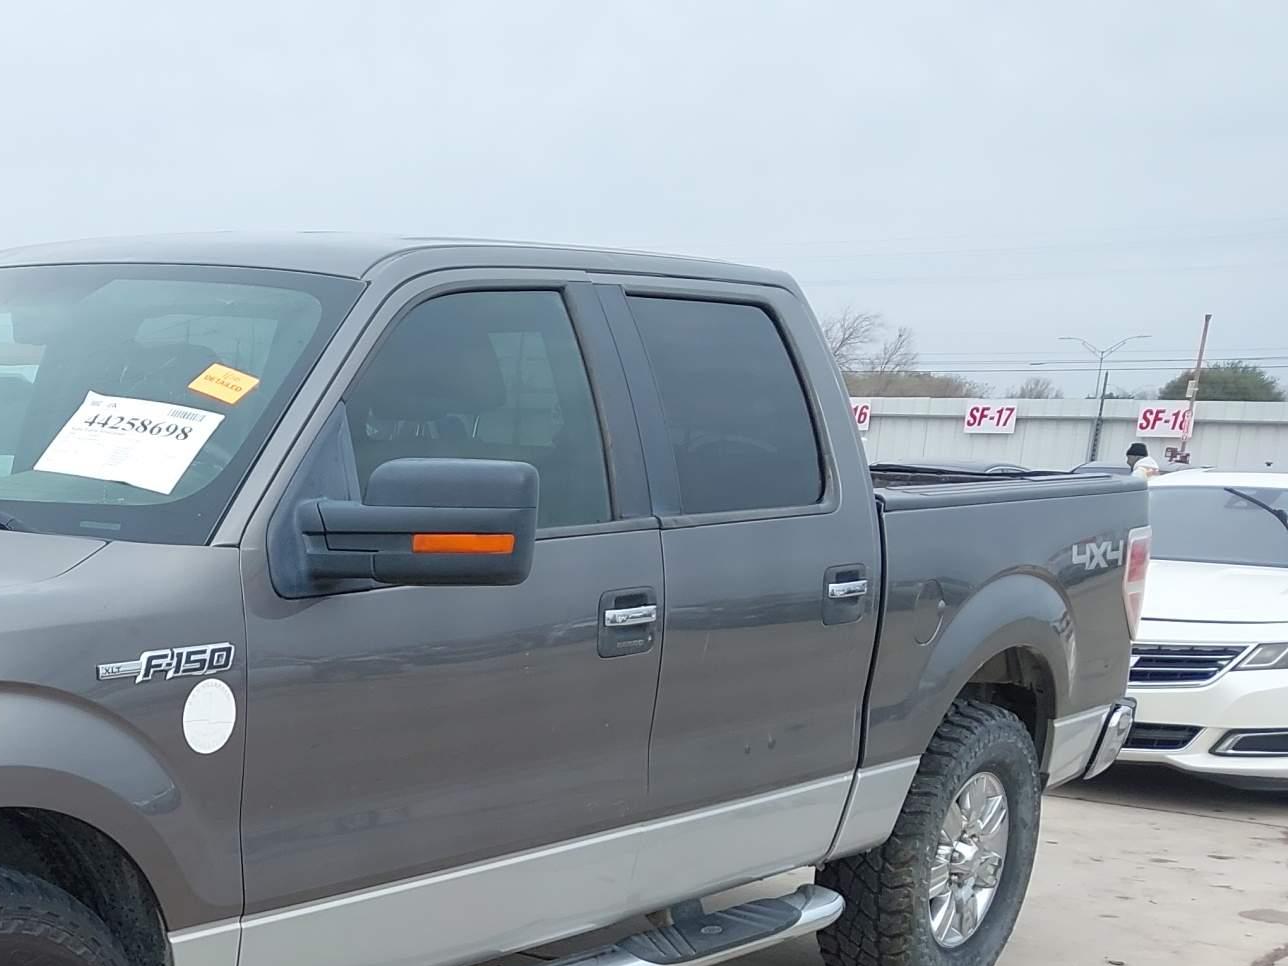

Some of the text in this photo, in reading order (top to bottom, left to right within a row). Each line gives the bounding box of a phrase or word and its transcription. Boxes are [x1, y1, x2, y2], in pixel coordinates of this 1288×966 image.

[83, 413, 193, 441] 44258698
[966, 406, 1016, 427] SF-17
[104, 643, 235, 680] XLT F-150
